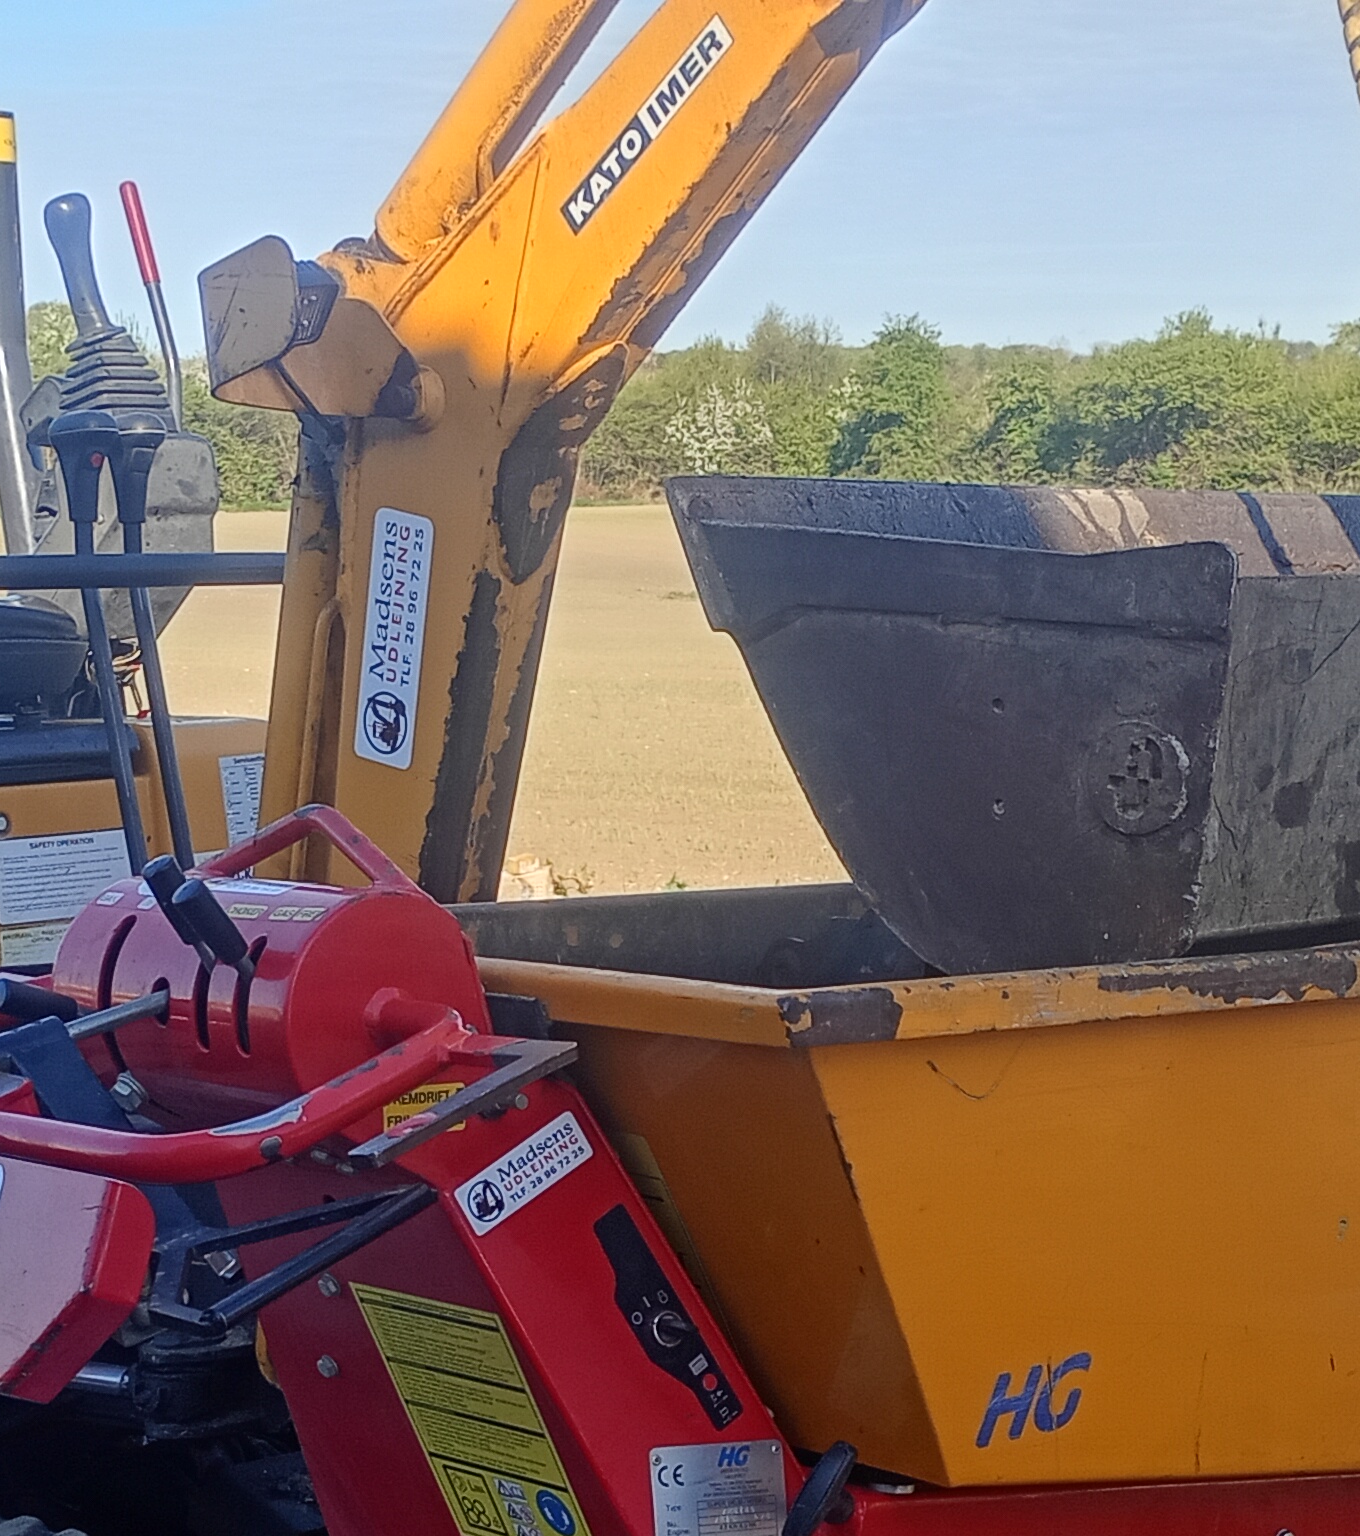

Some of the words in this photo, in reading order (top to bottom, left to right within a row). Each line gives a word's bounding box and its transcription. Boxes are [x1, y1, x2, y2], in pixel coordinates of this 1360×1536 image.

[567, 129, 642, 225] KATO
[646, 30, 723, 127] IMER
[413, 528, 424, 552] 25
[411, 559, 421, 582] 72
[369, 521, 398, 682] Madsens
[386, 525, 410, 683] UDLEJNING
[408, 591, 419, 614] 96
[405, 622, 415, 645] 28
[400, 653, 413, 687] TLF.
[496, 1122, 573, 1184] Madsens
[503, 1135, 579, 1192] UDLEJNING
[510, 1188, 530, 1203] TLF.
[529, 1177, 544, 1189] 28
[544, 1167, 558, 1180] 96
[558, 1156, 571, 1169] 72
[572, 1146, 585, 1159] 25
[976, 1352, 1092, 1449] HG
[718, 1445, 750, 1467] HG
